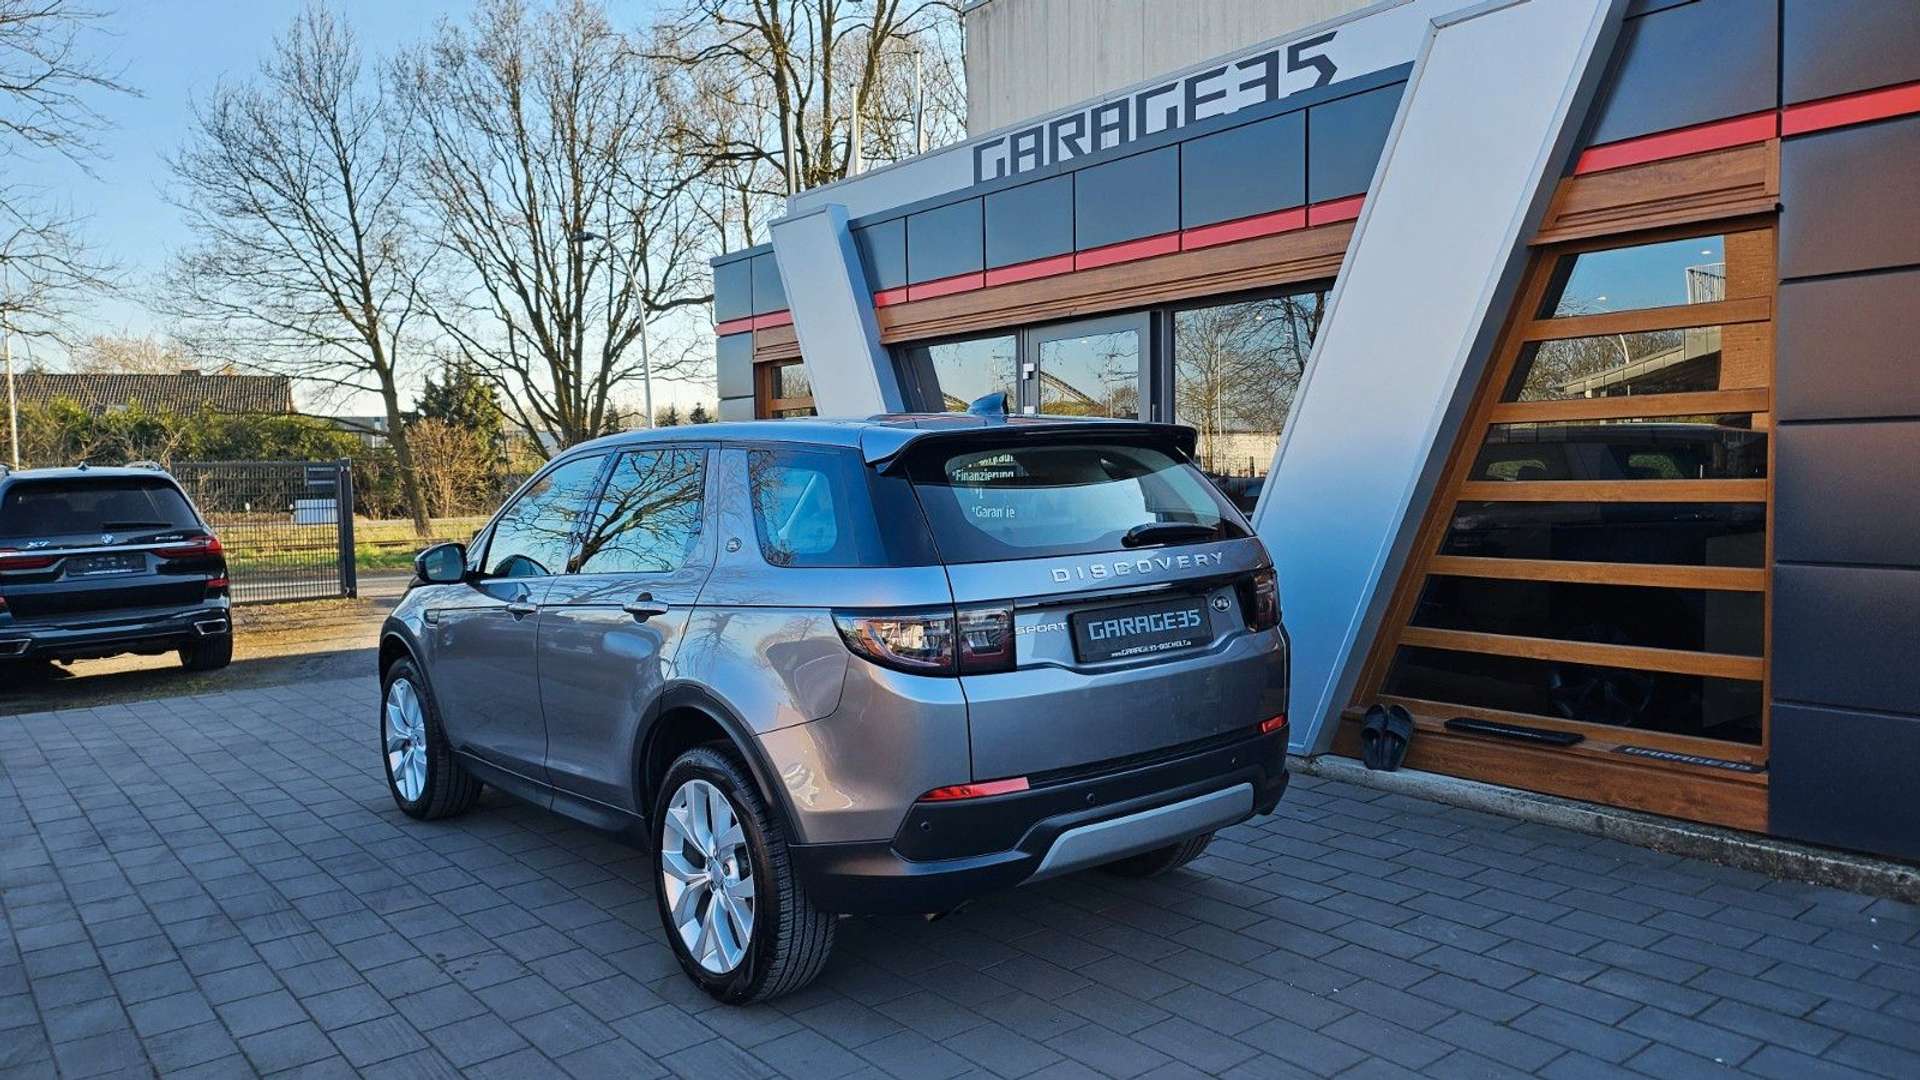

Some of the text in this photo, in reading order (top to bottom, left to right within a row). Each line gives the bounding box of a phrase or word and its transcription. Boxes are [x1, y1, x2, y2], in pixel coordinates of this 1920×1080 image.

[973, 30, 1338, 186] GARAGE35
[975, 505, 1015, 518] Garanie
[1052, 552, 1224, 583] DISCOVERY
[1015, 621, 1068, 635] SPORT
[1088, 608, 1201, 641] GARAGE35
